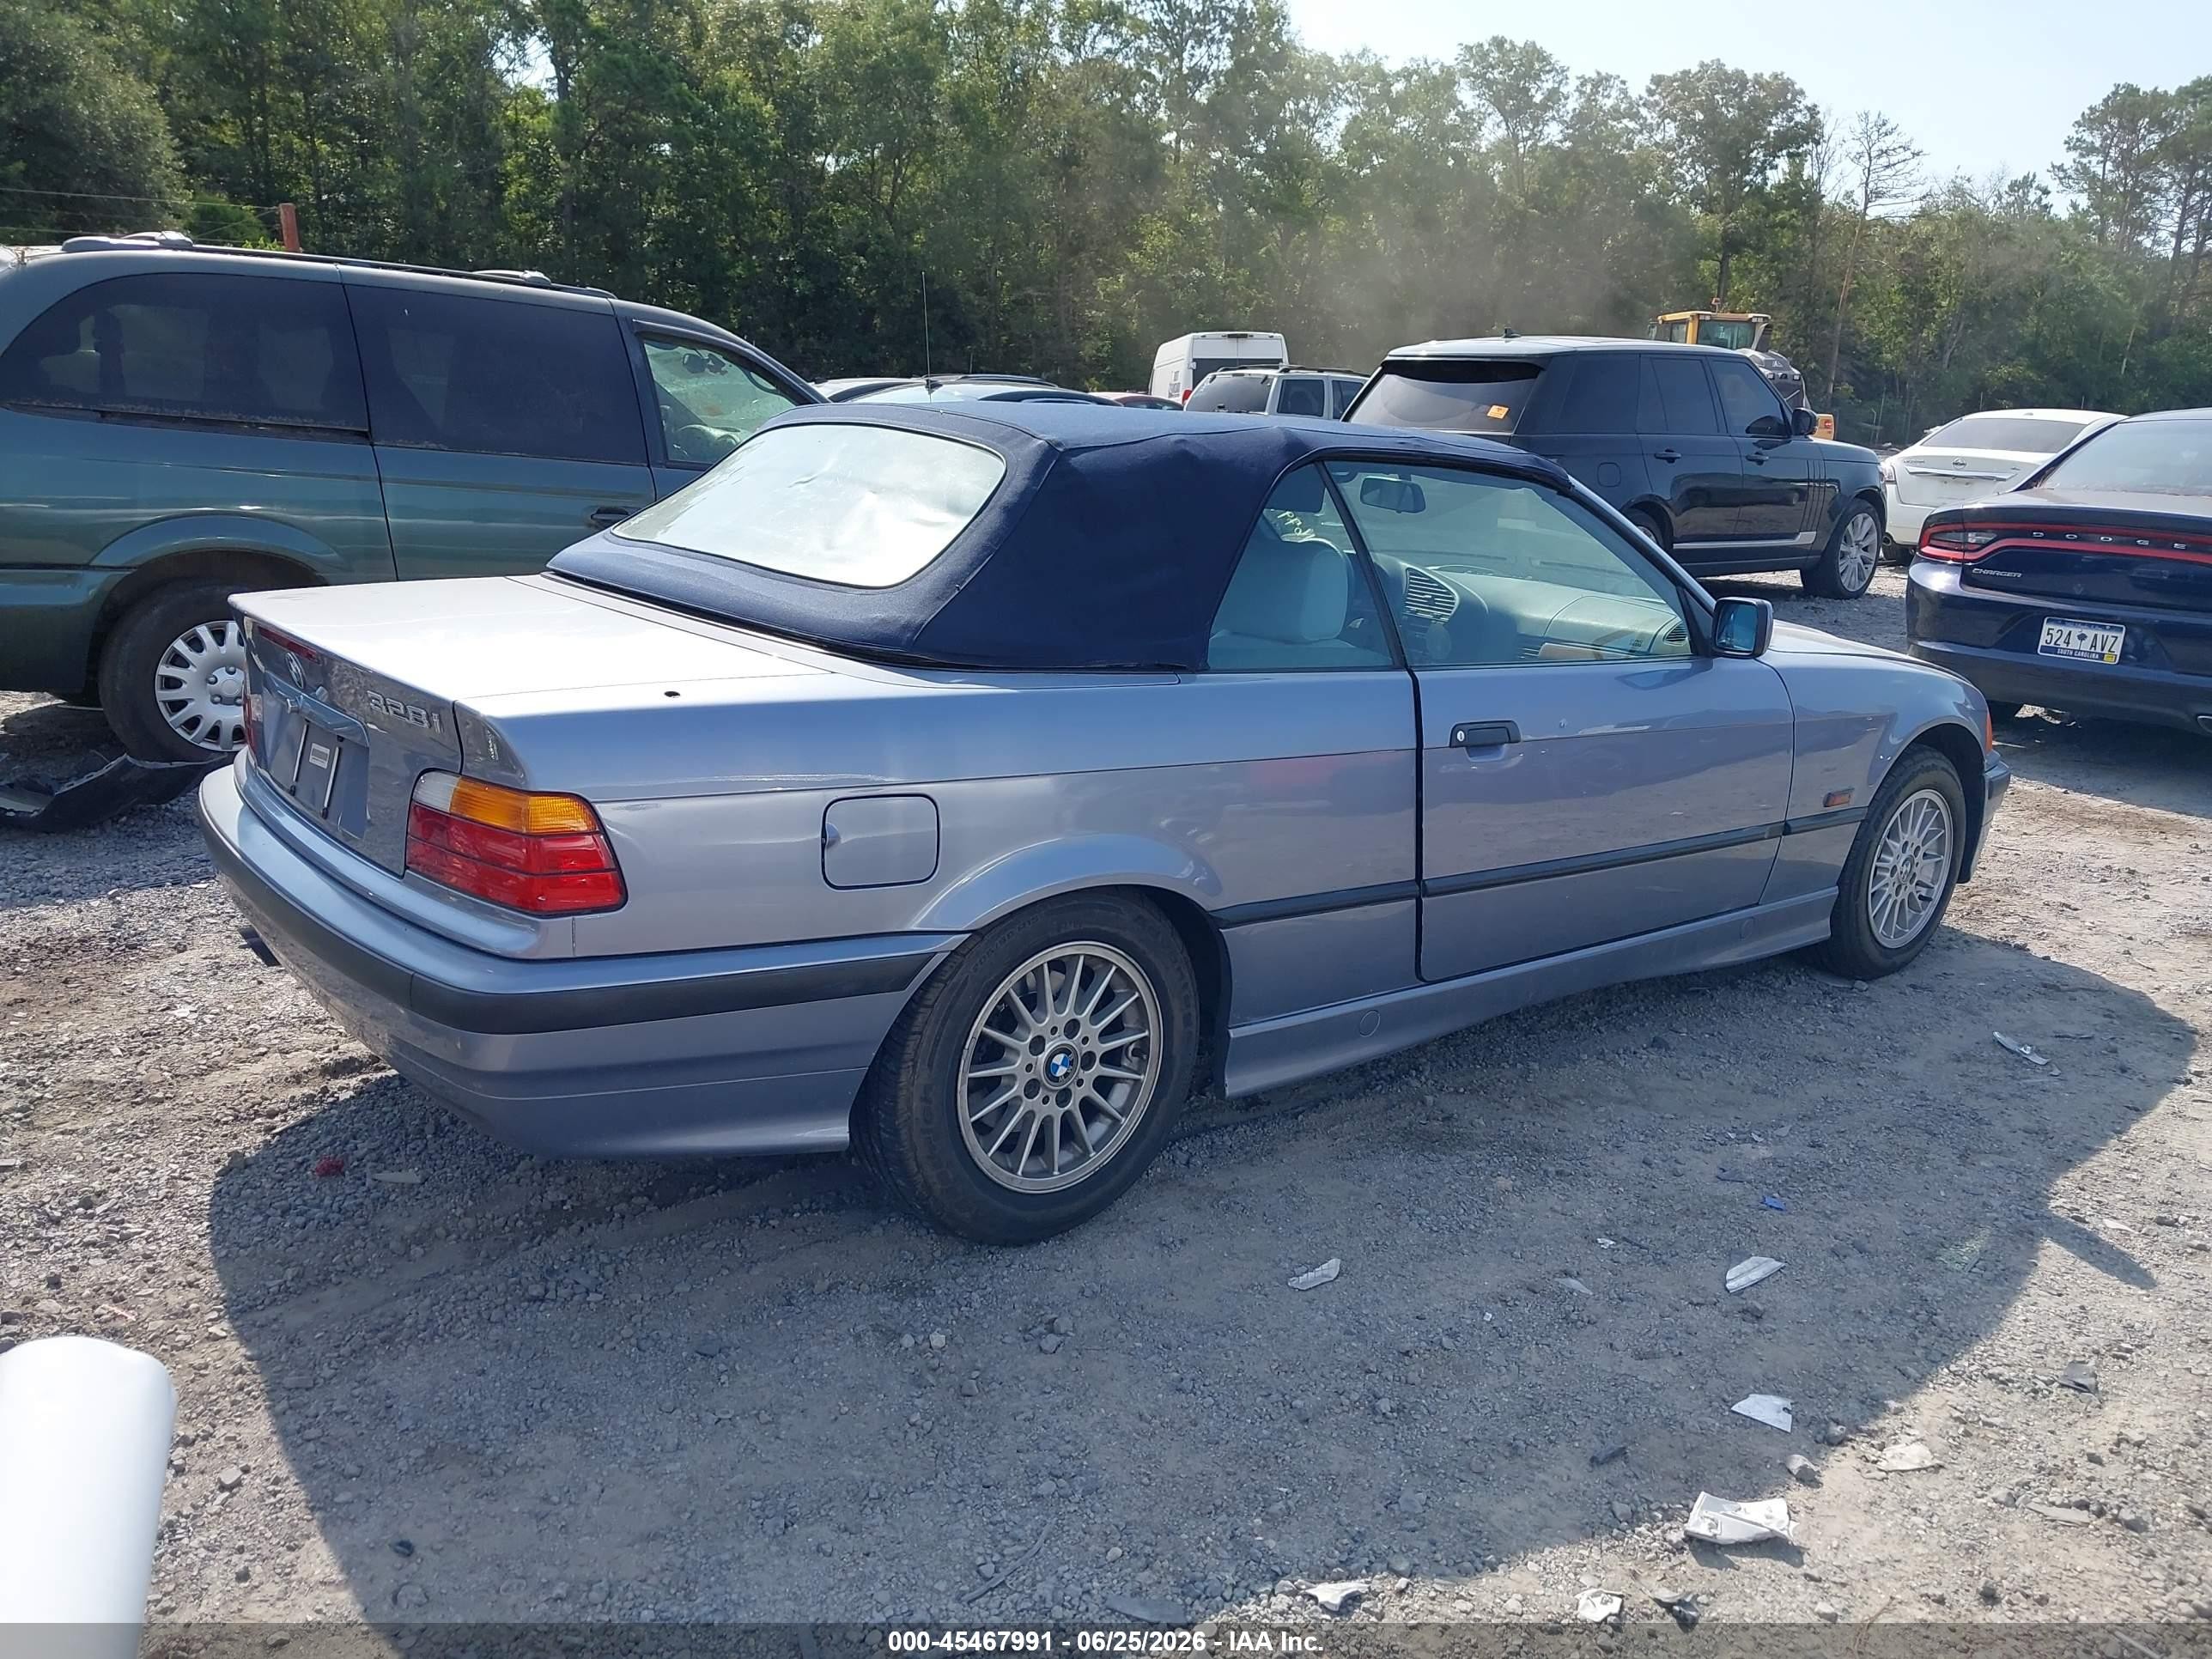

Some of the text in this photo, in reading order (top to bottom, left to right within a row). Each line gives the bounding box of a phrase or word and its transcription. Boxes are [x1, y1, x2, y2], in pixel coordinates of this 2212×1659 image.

[2033, 532, 2187, 550] DODGE
[1972, 568, 2023, 578] CHARGER
[2045, 628, 2118, 653] 524 AVZ
[2074, 649, 2100, 659] CAROLINA
[366, 690, 441, 733] 328i
